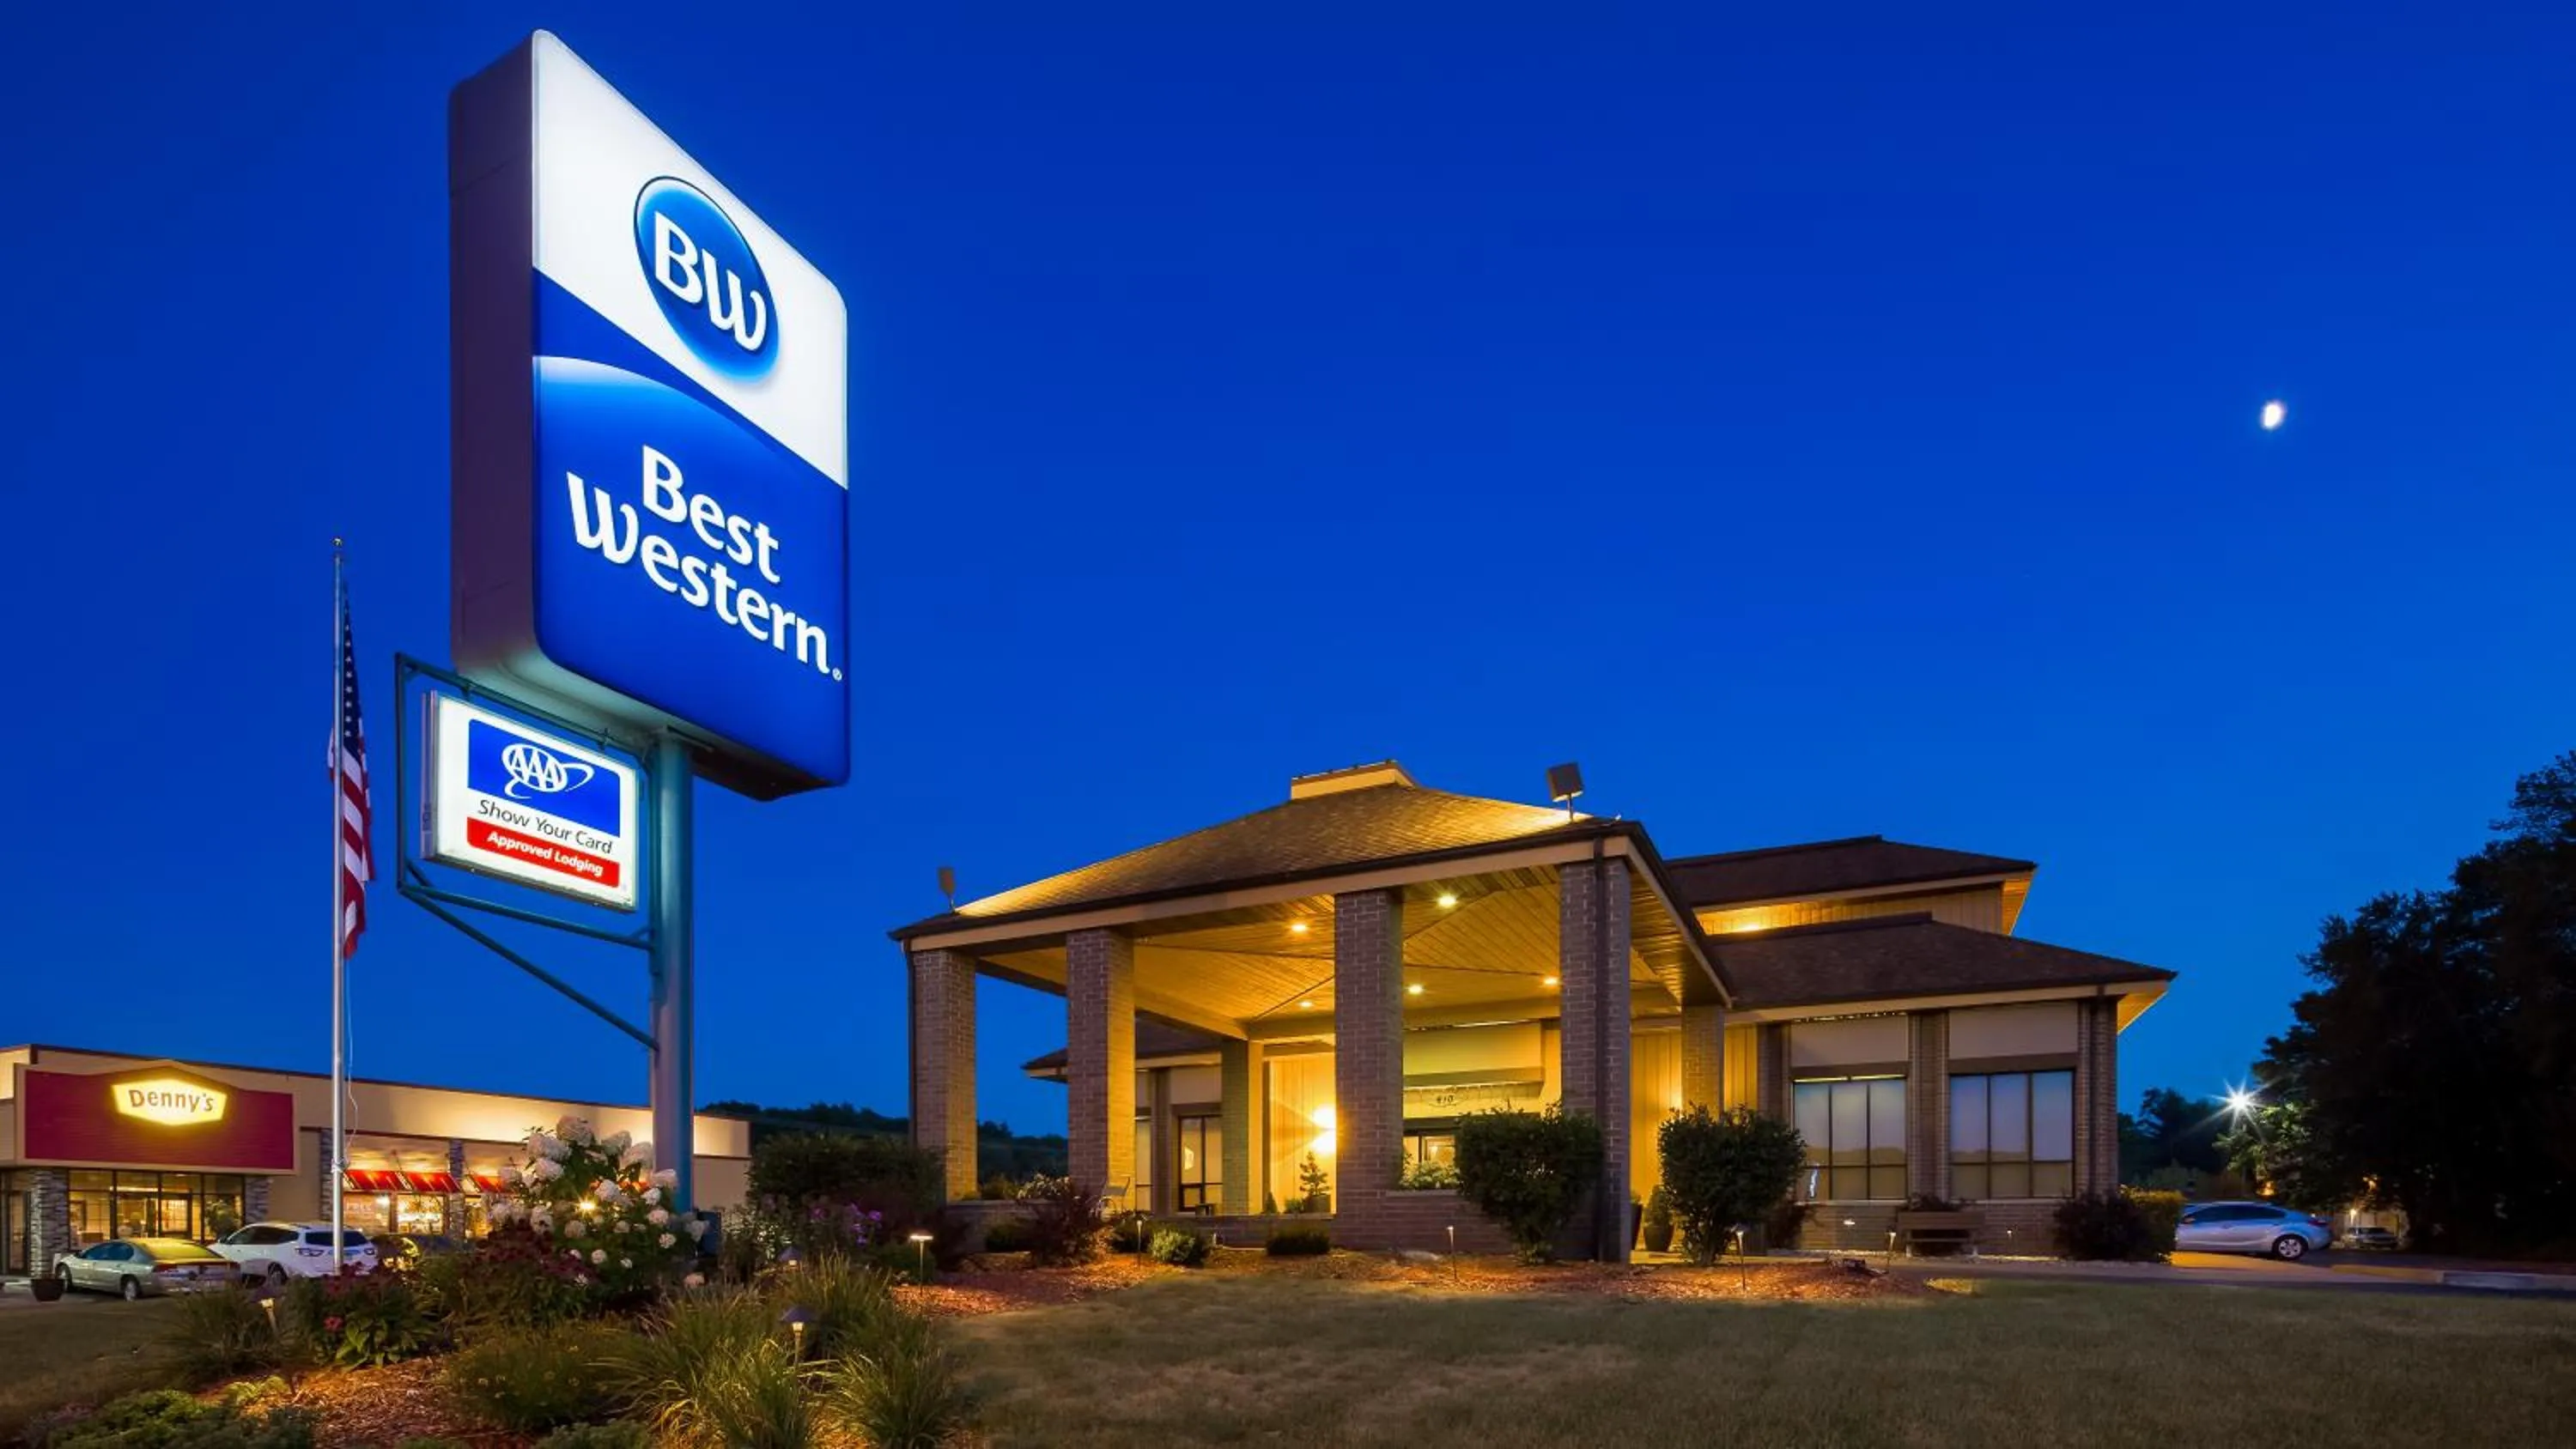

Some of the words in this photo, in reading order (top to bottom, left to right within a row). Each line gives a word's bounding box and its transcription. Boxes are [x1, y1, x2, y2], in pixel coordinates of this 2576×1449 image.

[655, 211, 766, 350] BW
[643, 444, 780, 584] Best
[567, 471, 829, 674] Western
[508, 748, 563, 790] AAA
[478, 799, 530, 828] Show
[535, 816, 572, 841] Your
[575, 830, 612, 854] Card
[487, 830, 552, 859] Approved
[554, 853, 604, 876] Lodging
[129, 1089, 214, 1113] Denny's
